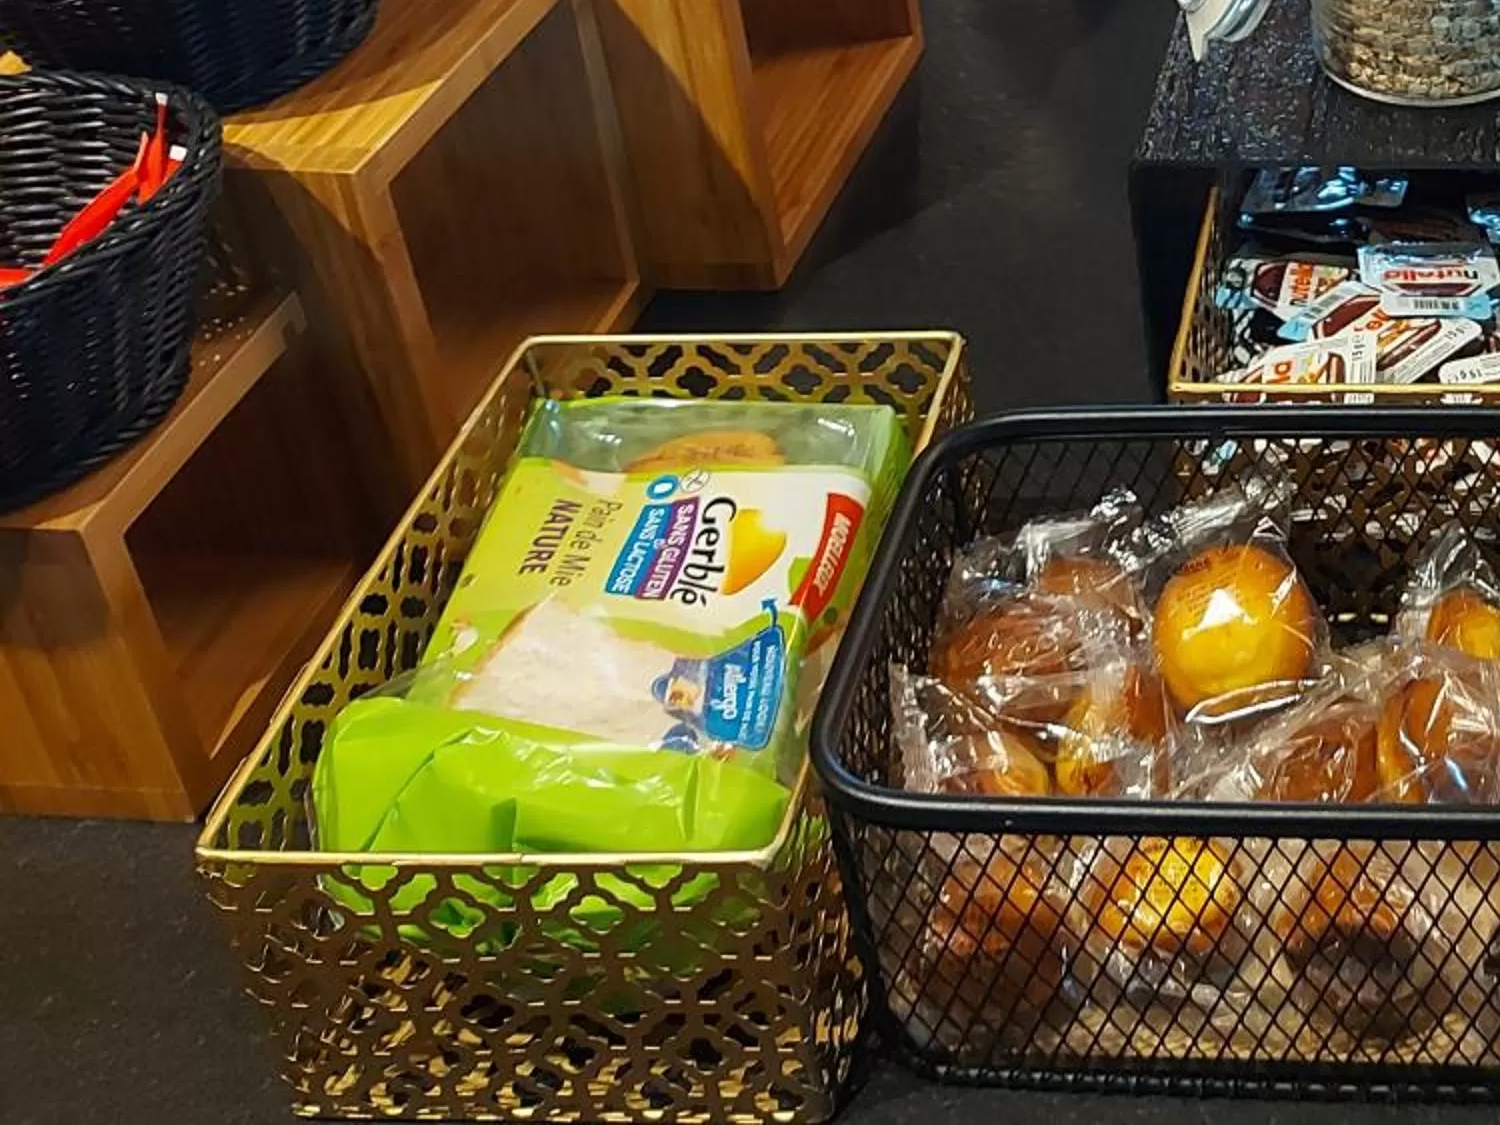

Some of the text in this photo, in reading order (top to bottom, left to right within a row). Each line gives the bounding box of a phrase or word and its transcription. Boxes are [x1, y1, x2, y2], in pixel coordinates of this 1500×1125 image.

[519, 499, 582, 575] NATURE
[550, 499, 623, 586] Pain de Mie
[611, 507, 666, 594] SANS LACTOSE
[644, 504, 695, 599] SANS GLUTEN
[670, 496, 737, 608] Gerblé
